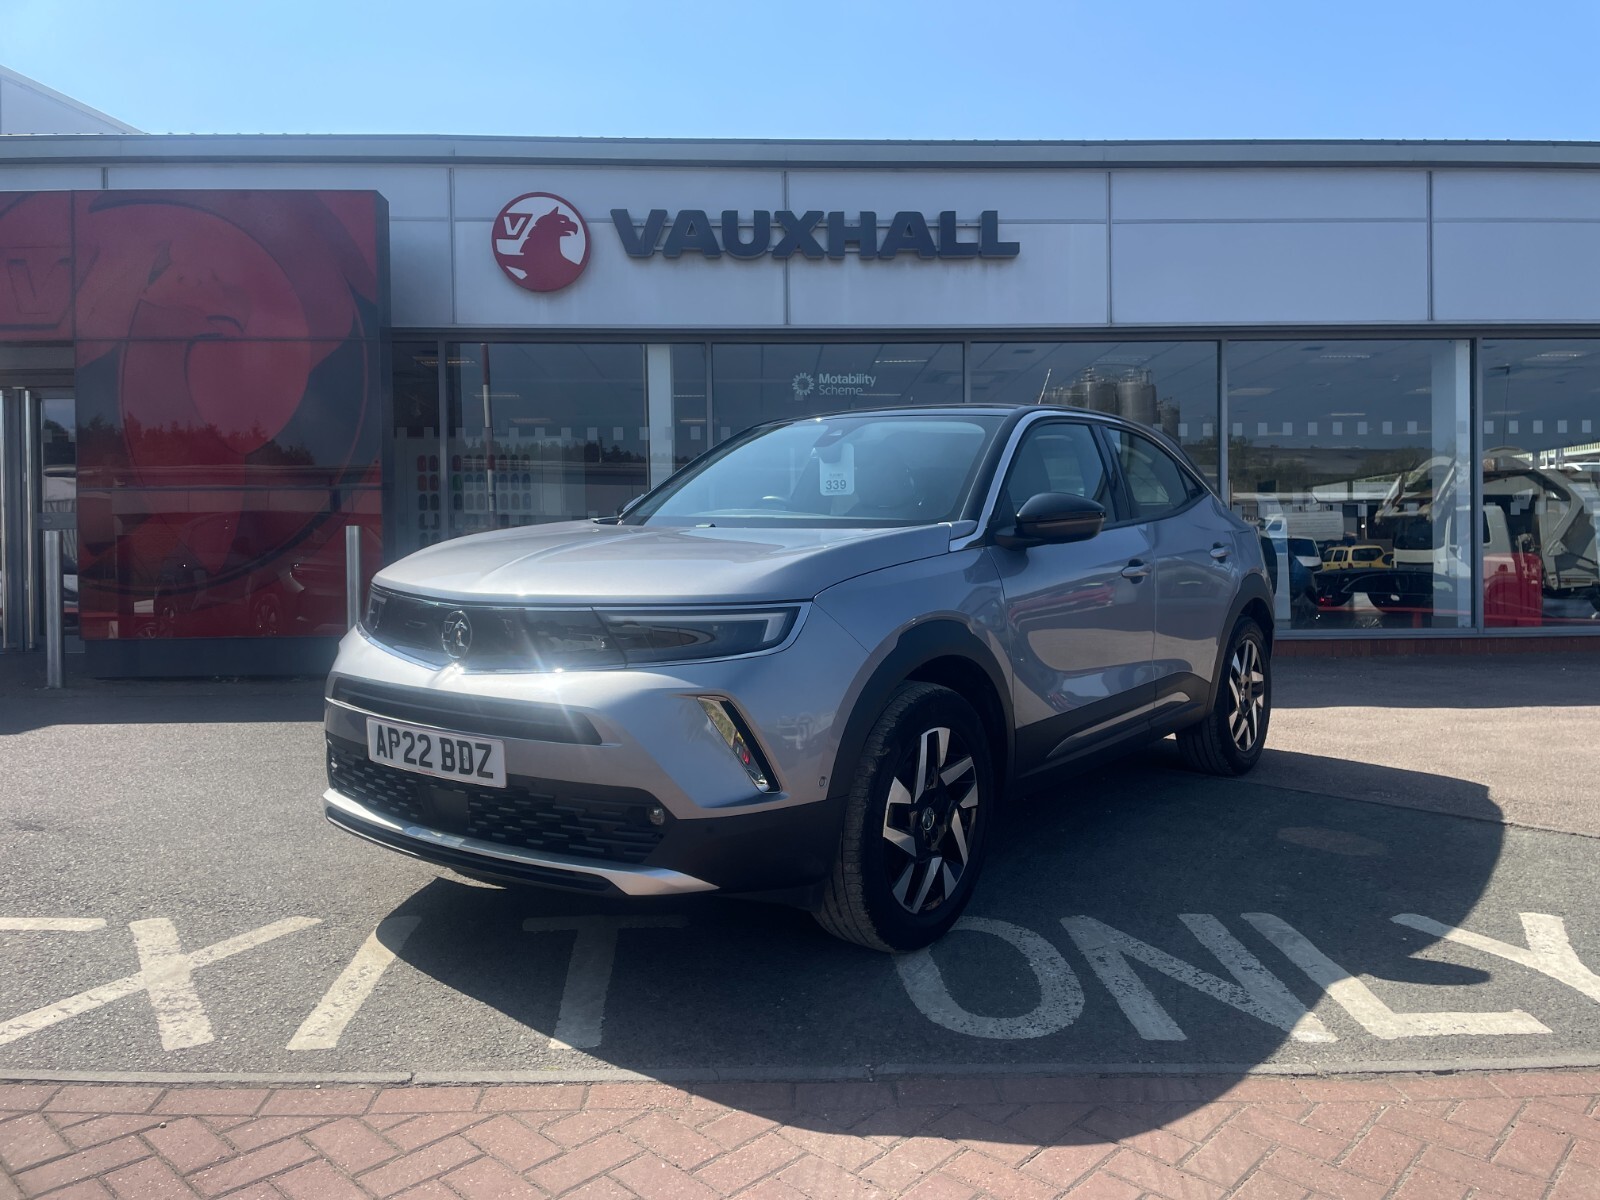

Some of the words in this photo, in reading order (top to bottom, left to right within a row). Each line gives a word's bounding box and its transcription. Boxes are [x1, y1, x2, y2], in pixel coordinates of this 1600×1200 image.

[610, 208, 1020, 258] VAUXHALL
[818, 373, 876, 387] Motability
[818, 384, 863, 396] Scheme
[826, 479, 847, 490] 339
[376, 724, 433, 768] AP22
[439, 737, 494, 779] BDZ
[0, 915, 690, 1051] XIT
[894, 911, 1600, 1043] ONLY
